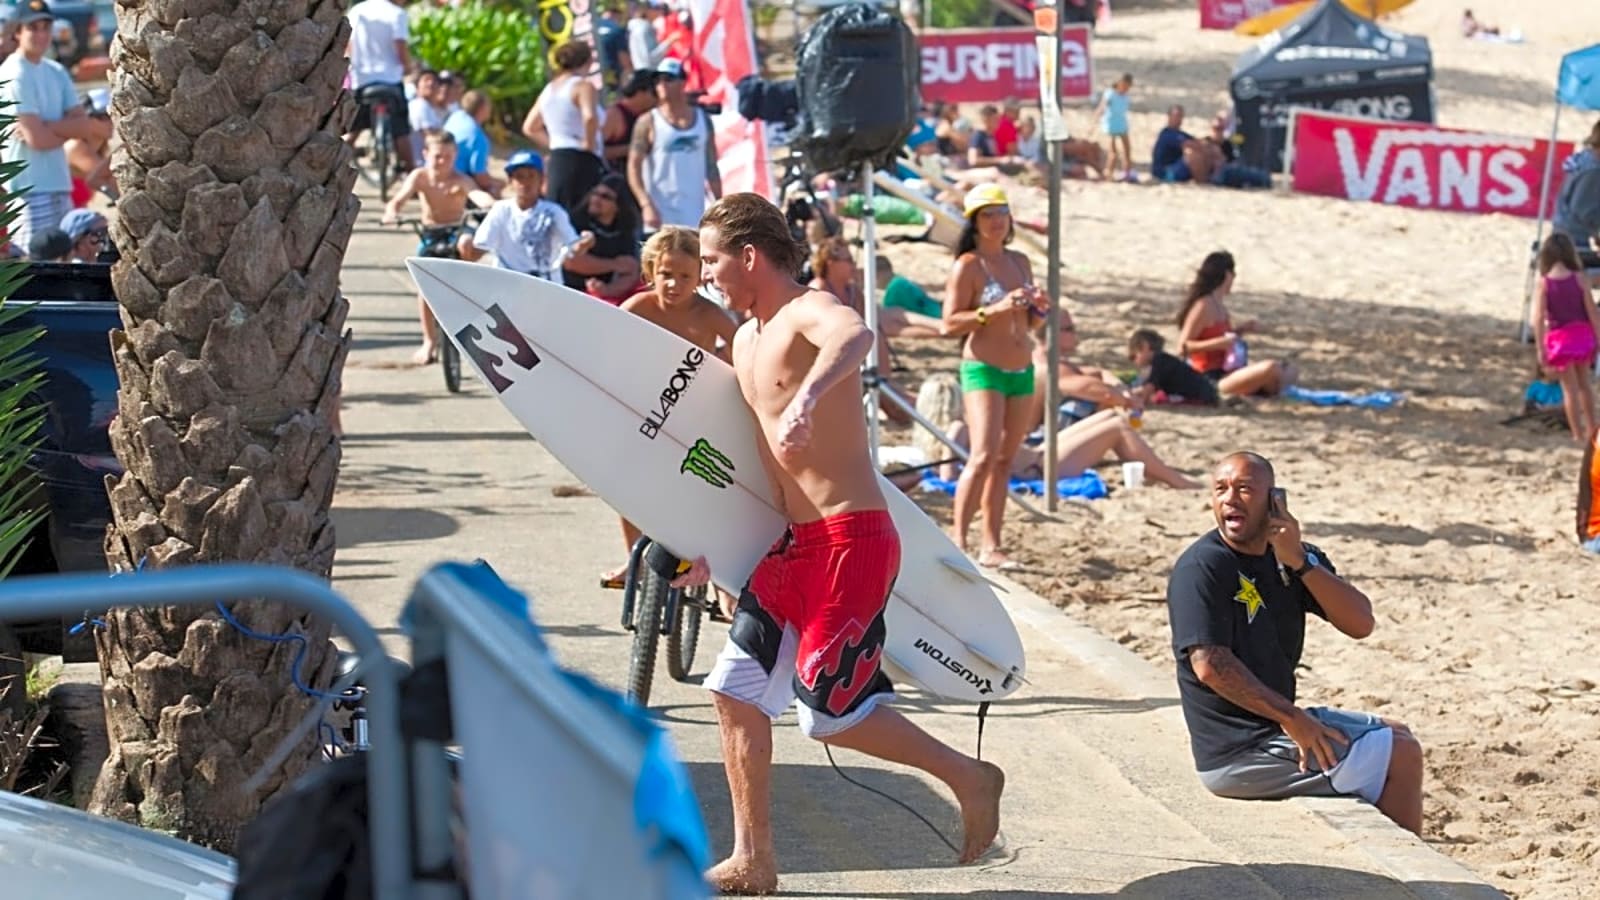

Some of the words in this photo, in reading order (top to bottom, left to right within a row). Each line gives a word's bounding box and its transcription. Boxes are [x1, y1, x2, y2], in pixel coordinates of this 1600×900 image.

[1333, 129, 1535, 207] VANS
[639, 347, 704, 440] BILLABONG
[913, 638, 985, 689] KUSTOM
